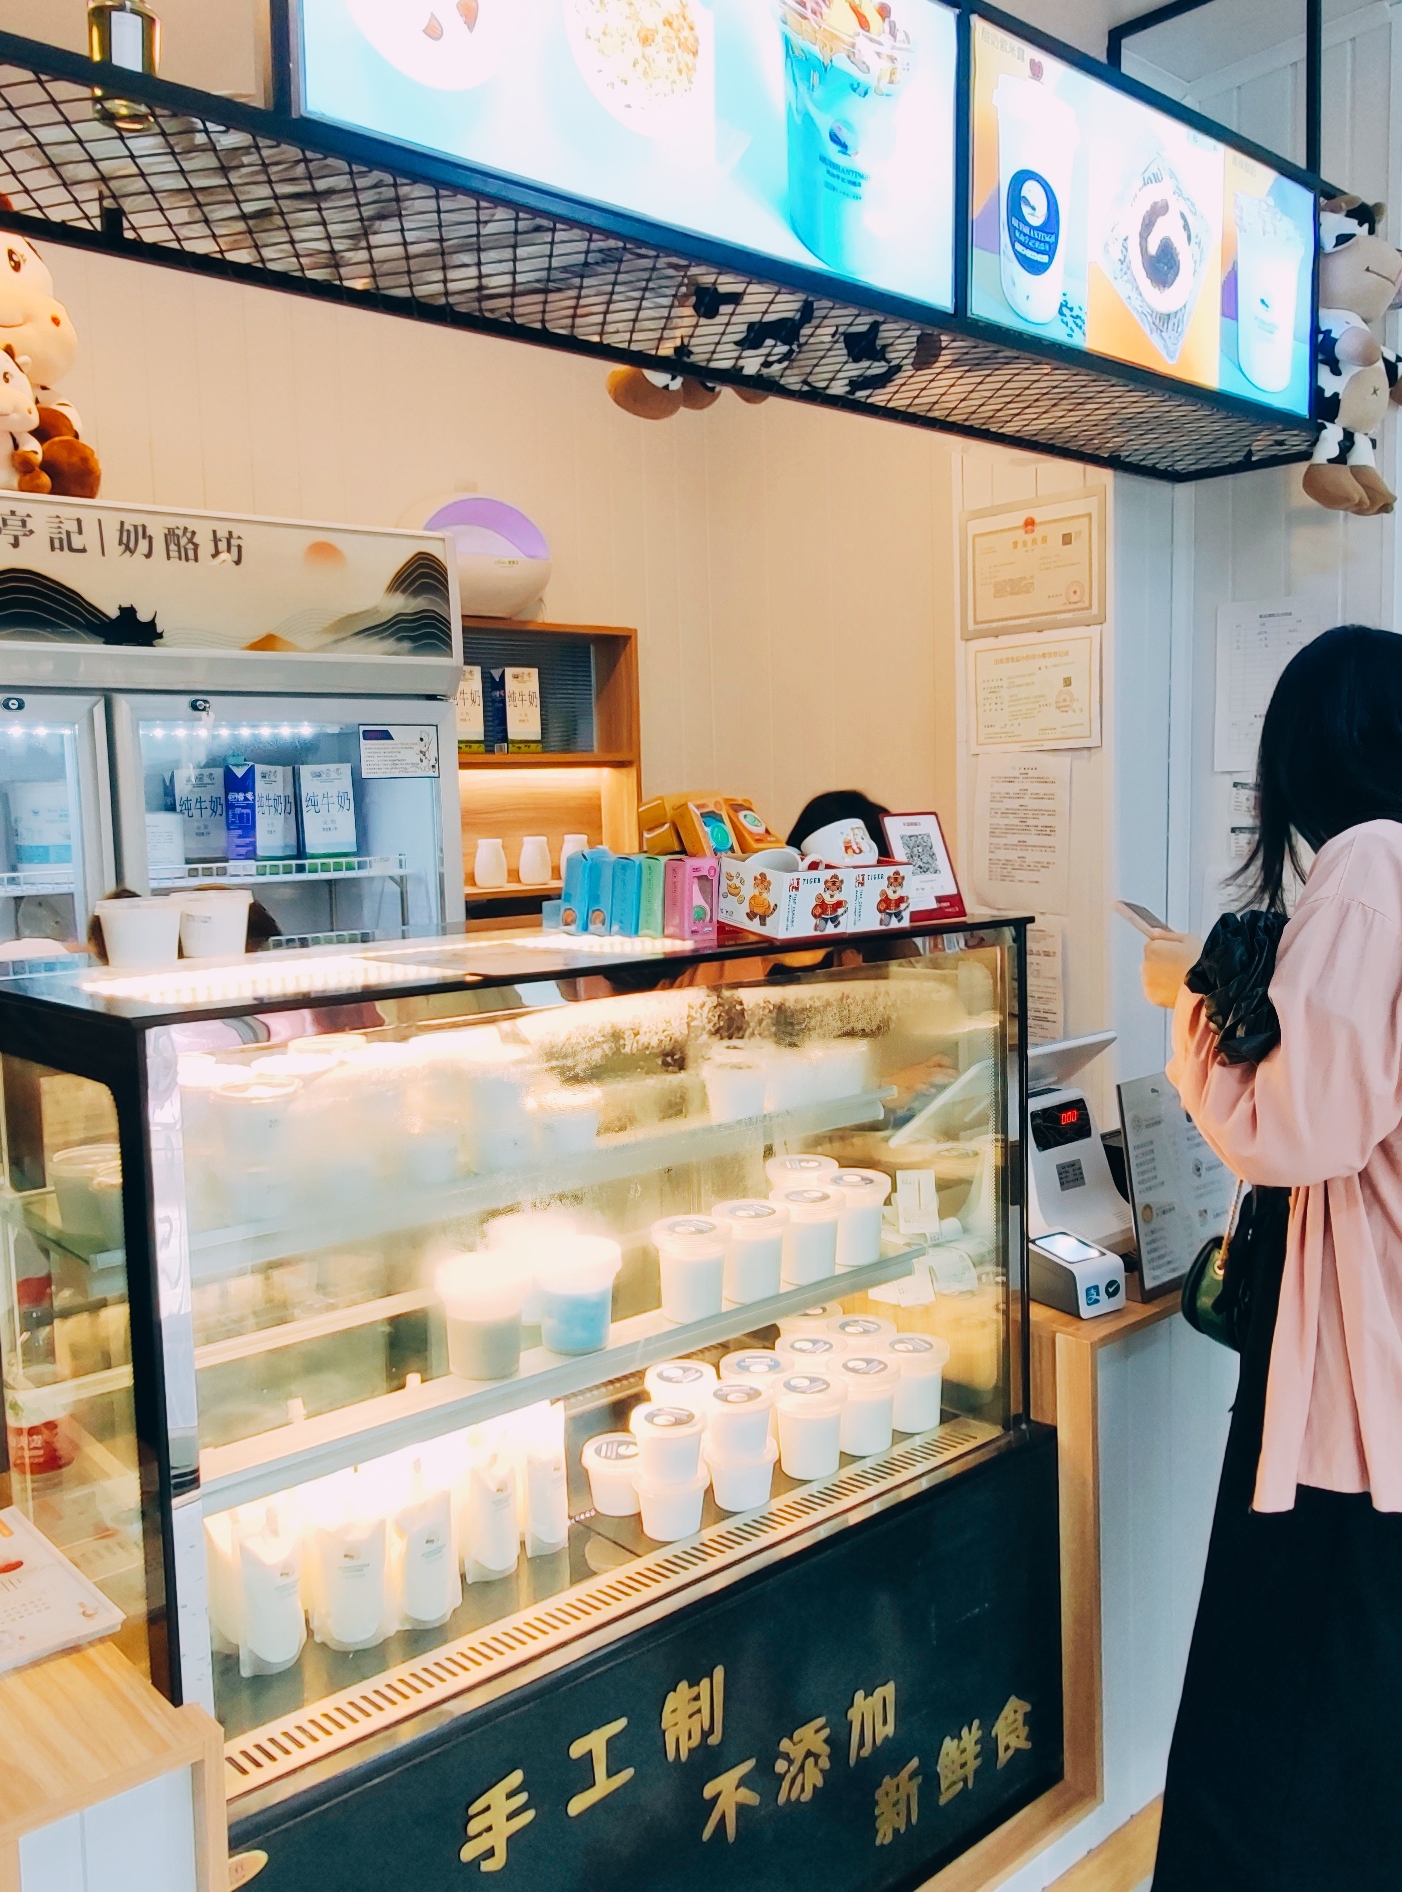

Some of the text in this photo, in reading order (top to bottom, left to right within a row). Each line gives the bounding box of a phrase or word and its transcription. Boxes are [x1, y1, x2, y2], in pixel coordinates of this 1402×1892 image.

[507, 690, 538, 708] 纯牛奶
[179, 795, 224, 819] 纯牛奶
[257, 791, 282, 816] 纯牛奶
[304, 790, 351, 815] 纯牛奶
[802, 876, 822, 887] TIGER
[867, 873, 885, 882] TIGER
[458, 1664, 725, 1873] 手工制
[700, 1679, 896, 1844] 不添加
[873, 1694, 1033, 1847] 新鲜食
